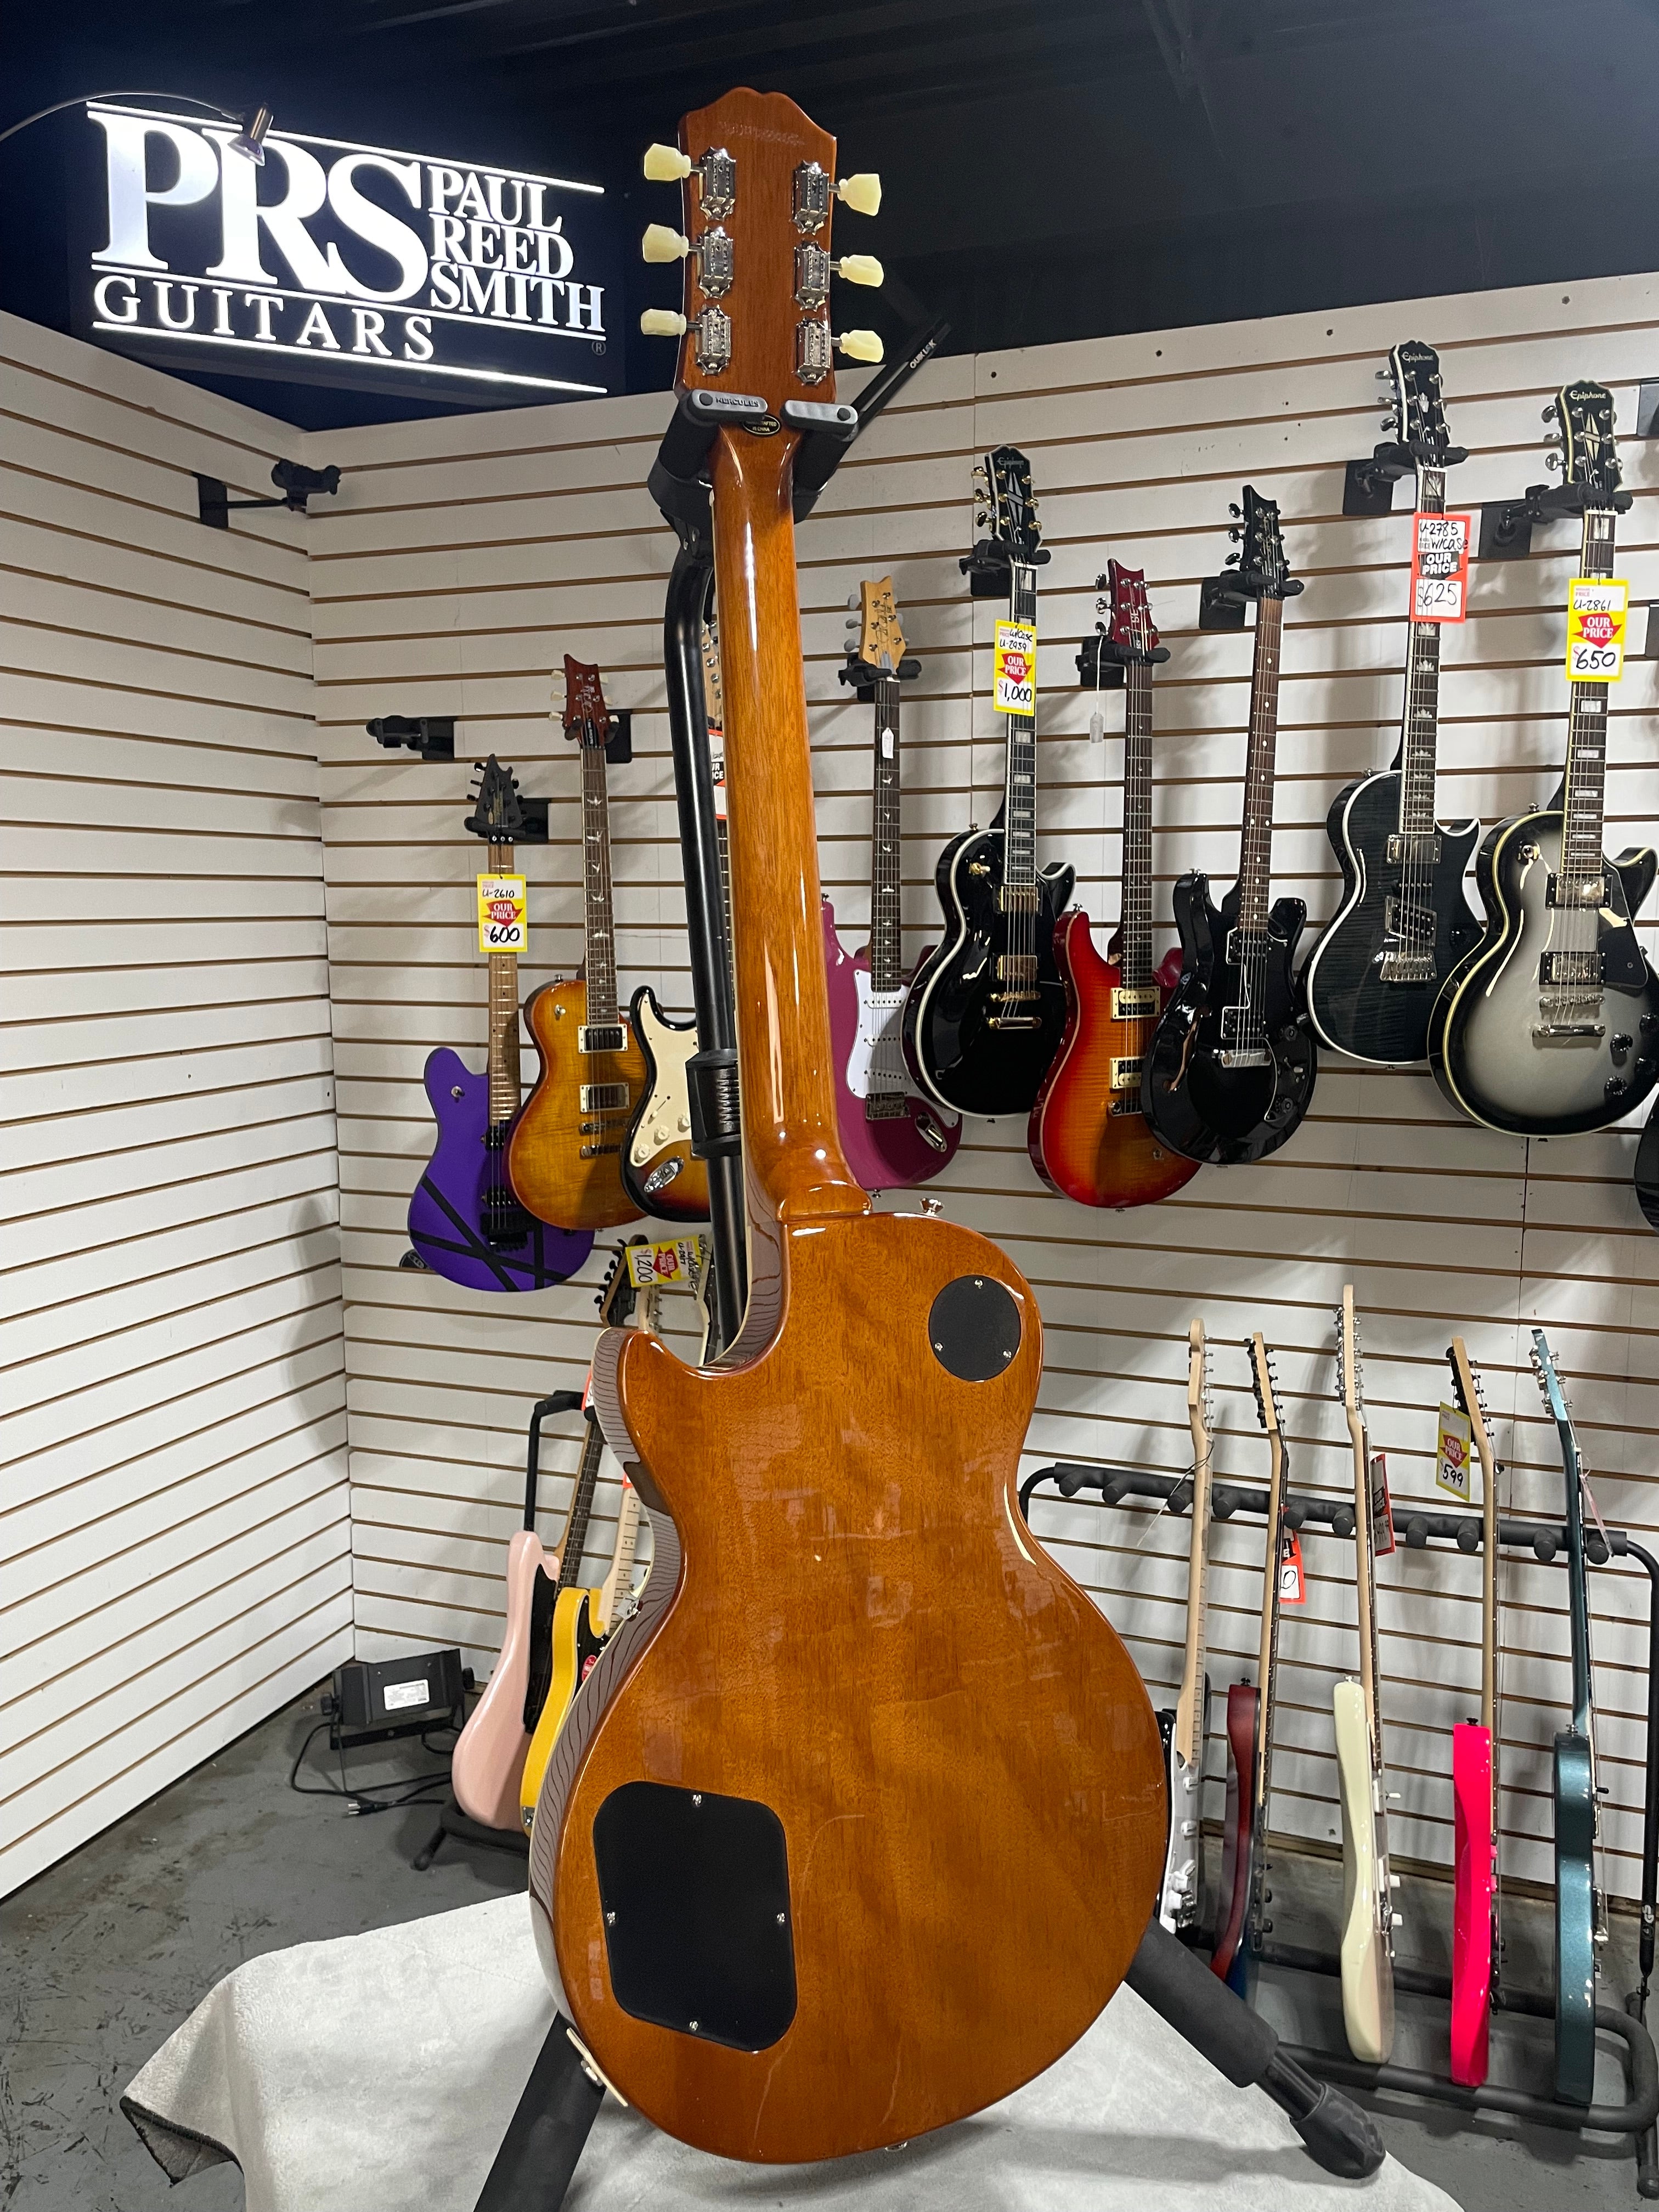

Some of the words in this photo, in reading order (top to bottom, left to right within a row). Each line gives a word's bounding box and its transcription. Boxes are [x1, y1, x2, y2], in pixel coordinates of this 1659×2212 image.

[87, 110, 428, 302] PRS
[428, 165, 562, 234] PAUL
[430, 213, 574, 279] REED
[431, 261, 605, 332] SMITH
[94, 274, 435, 361] GUITARS
[715, 397, 759, 408] HERCULES
[1569, 390, 1606, 401] Epiphone
[1426, 552, 1452, 565] OUR
[1422, 561, 1458, 575] PRICE
[1418, 583, 1457, 607] $625
[1587, 617, 1610, 628] OUR
[1583, 627, 1614, 639] PRICE
[1007, 655, 1024, 667] OUR
[1572, 645, 1616, 669] $650
[1005, 664, 1027, 676] PRICE
[998, 680, 1032, 702] $1,000
[491, 911, 517, 920] PRICE
[493, 903, 513, 912] OUR
[483, 924, 520, 943] $600
[634, 1248, 653, 1283] $1,200
[666, 1254, 675, 1271] OUR
[1447, 1438, 1460, 1452] OUR
[1445, 1446, 1463, 1462] PRICE
[1440, 1457, 1464, 1487] $599
